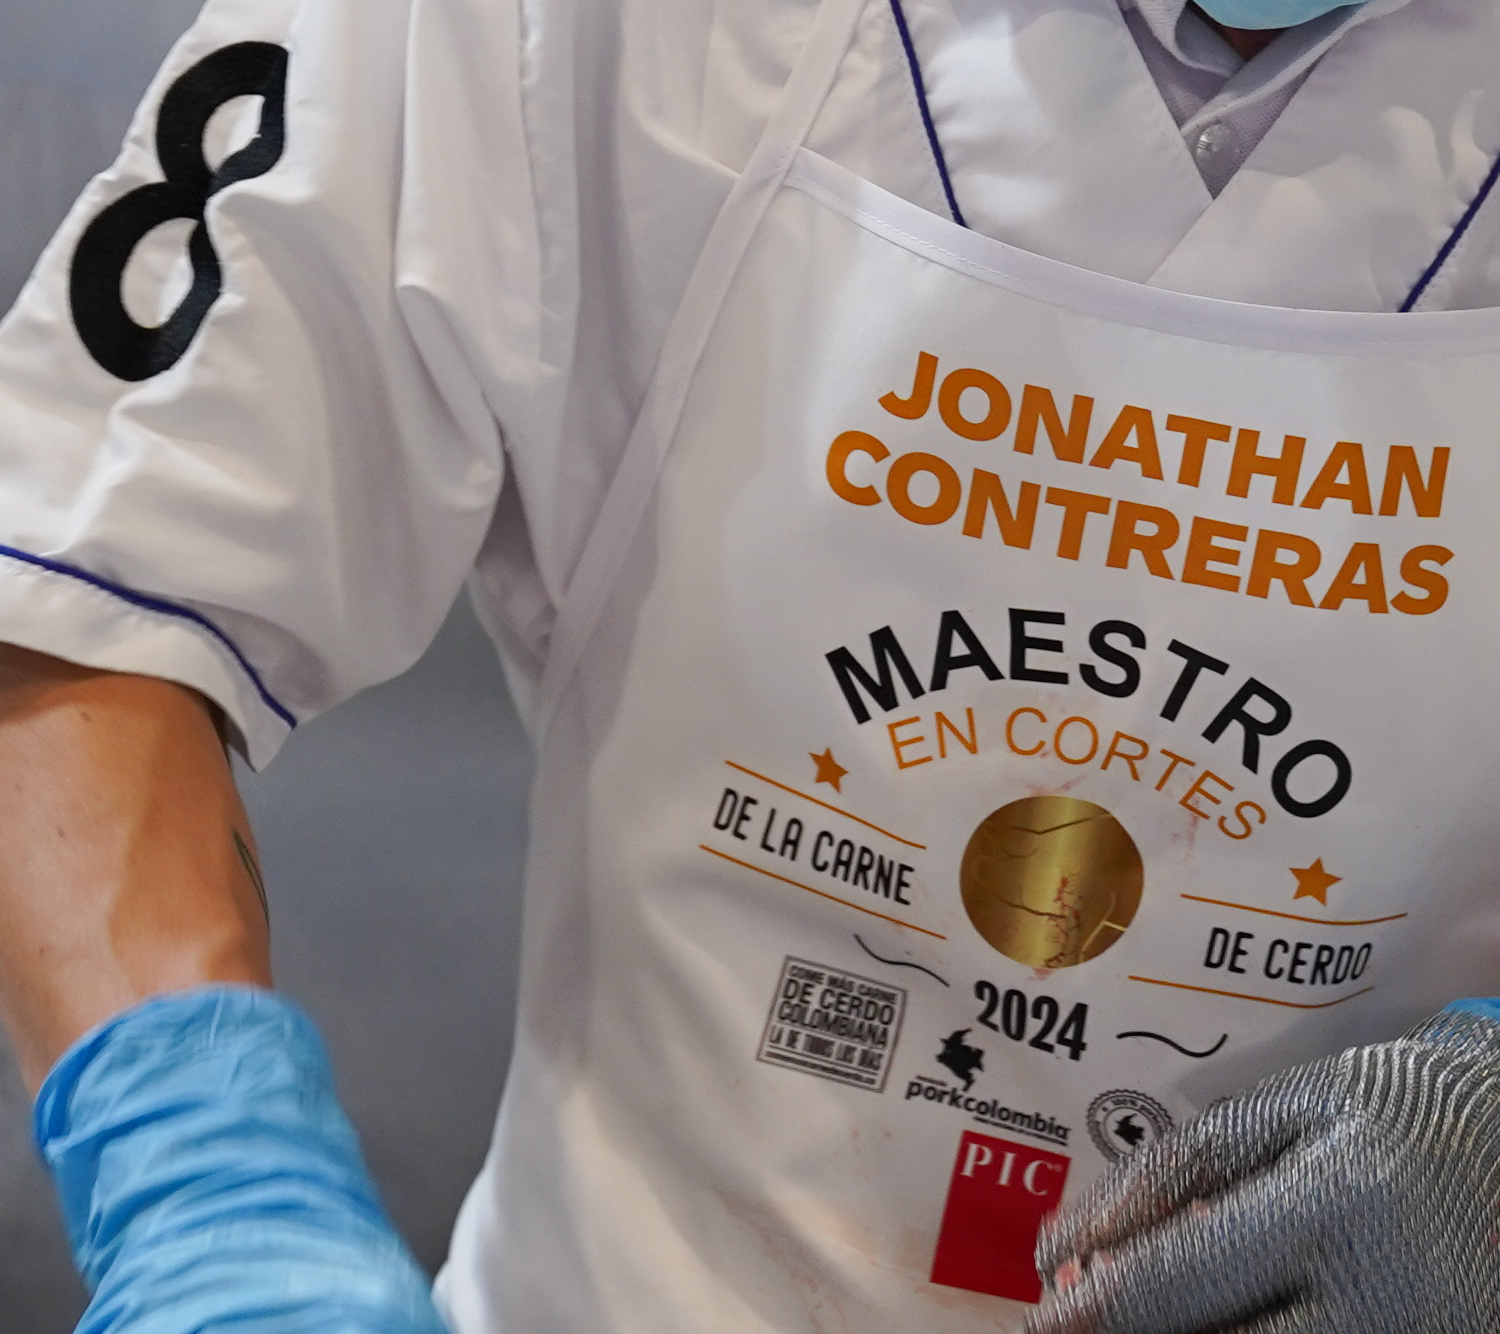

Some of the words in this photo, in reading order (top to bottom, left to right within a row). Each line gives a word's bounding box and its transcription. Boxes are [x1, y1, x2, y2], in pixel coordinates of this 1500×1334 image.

[70, 40, 289, 382] 8
[877, 351, 1452, 518] JONATHAN
[825, 430, 1456, 616] CONTRERAS
[824, 607, 1353, 819] MAESTRO
[887, 706, 979, 769] EN
[1004, 706, 1269, 841] CORTES
[713, 787, 758, 840] DE
[760, 808, 804, 861] LA
[810, 830, 915, 906] CARNE
[783, 979, 815, 1004] DE
[820, 988, 895, 1025] CERDO
[1204, 927, 1254, 974] DE
[1264, 939, 1372, 985] CERDO
[778, 1001, 889, 1048] COLOMBIANA
[974, 980, 1089, 1061] 2024
[904, 1080, 1071, 1139] porkcolombia
